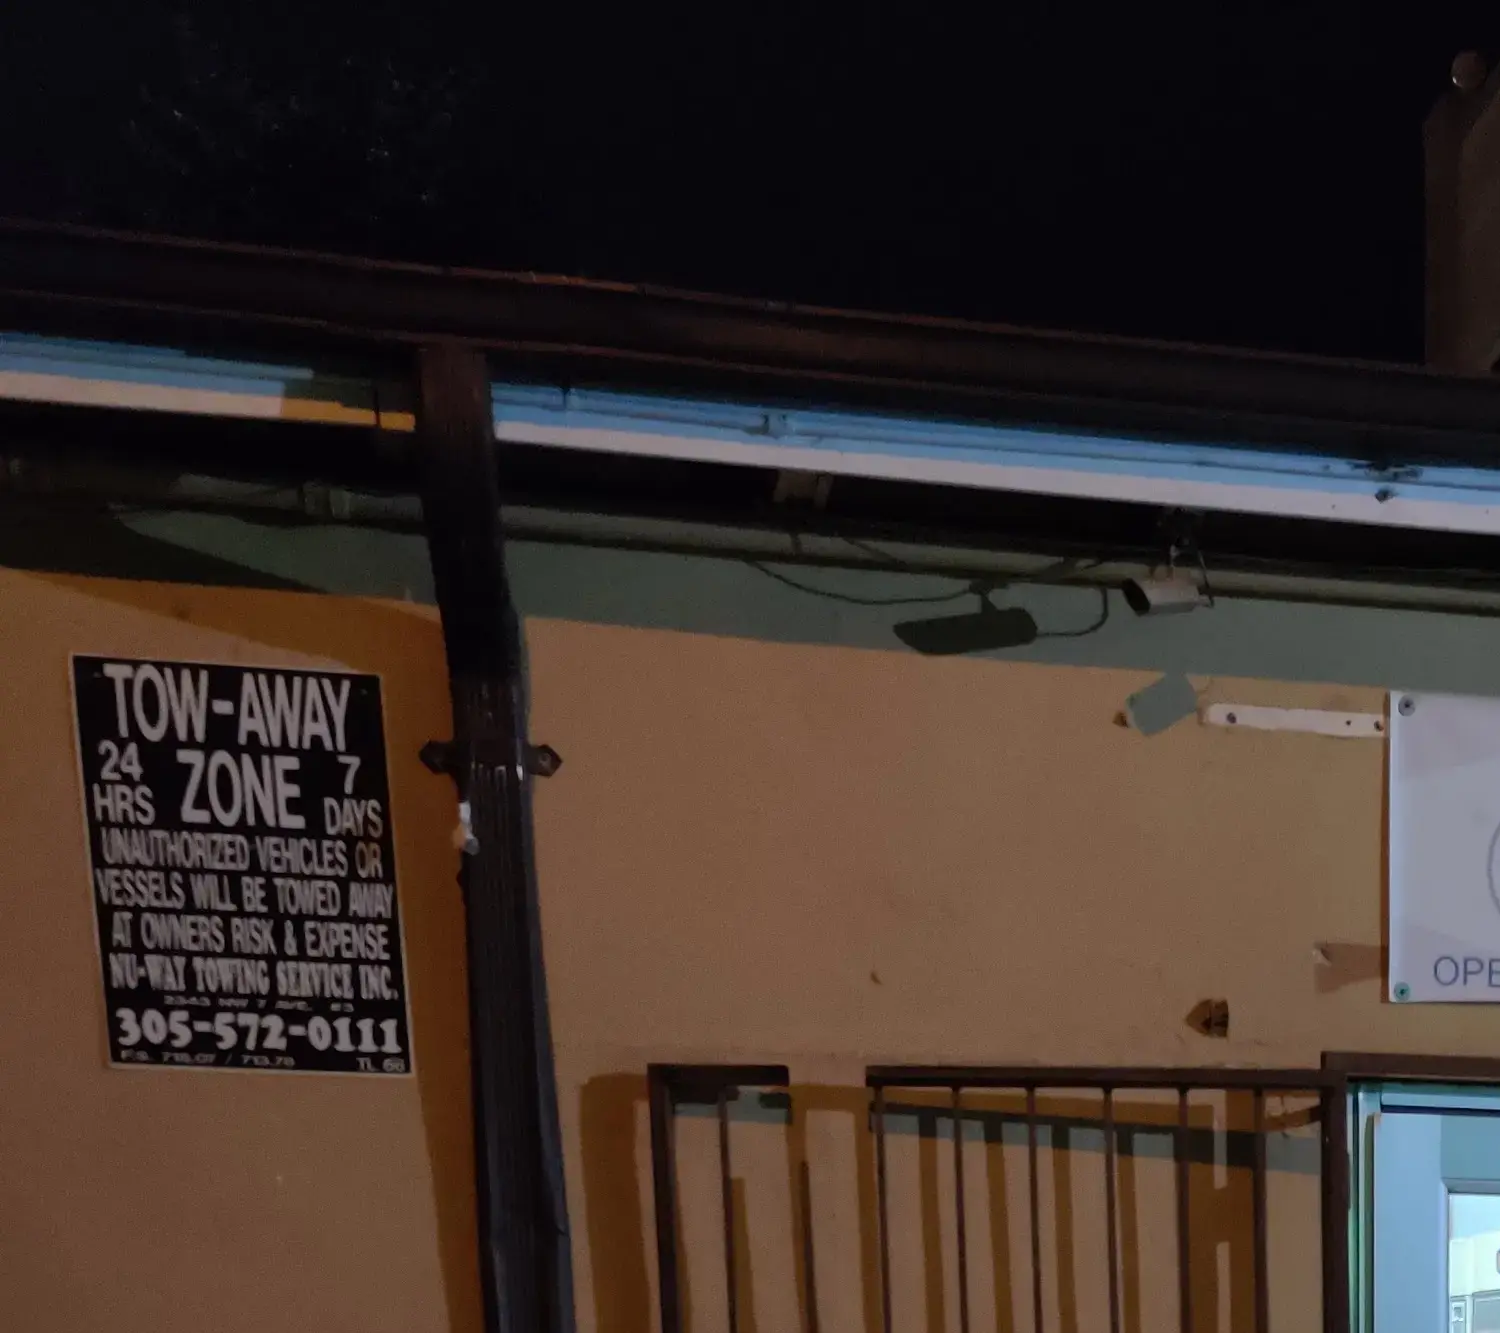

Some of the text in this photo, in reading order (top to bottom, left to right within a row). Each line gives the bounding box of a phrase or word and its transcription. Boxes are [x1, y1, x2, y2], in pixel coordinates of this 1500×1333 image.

[103, 663, 350, 751] TOW-AWAY
[98, 740, 143, 781] 24
[336, 756, 360, 795] 7
[93, 784, 155, 825] HRS
[176, 750, 305, 829] ZONE
[324, 797, 381, 838] DAYS
[101, 828, 383, 878] UNAUTHORIZED VEHICLES OR
[95, 868, 393, 918] VESSELS WILL BE TOWED AWAY
[112, 911, 390, 960] AT OWNERS RISK & EXPENSE
[192, 956, 270, 995] TOWING
[276, 960, 354, 999] SERVICE
[358, 964, 398, 999] INC.
[116, 1007, 402, 1053] 305-572-0111
